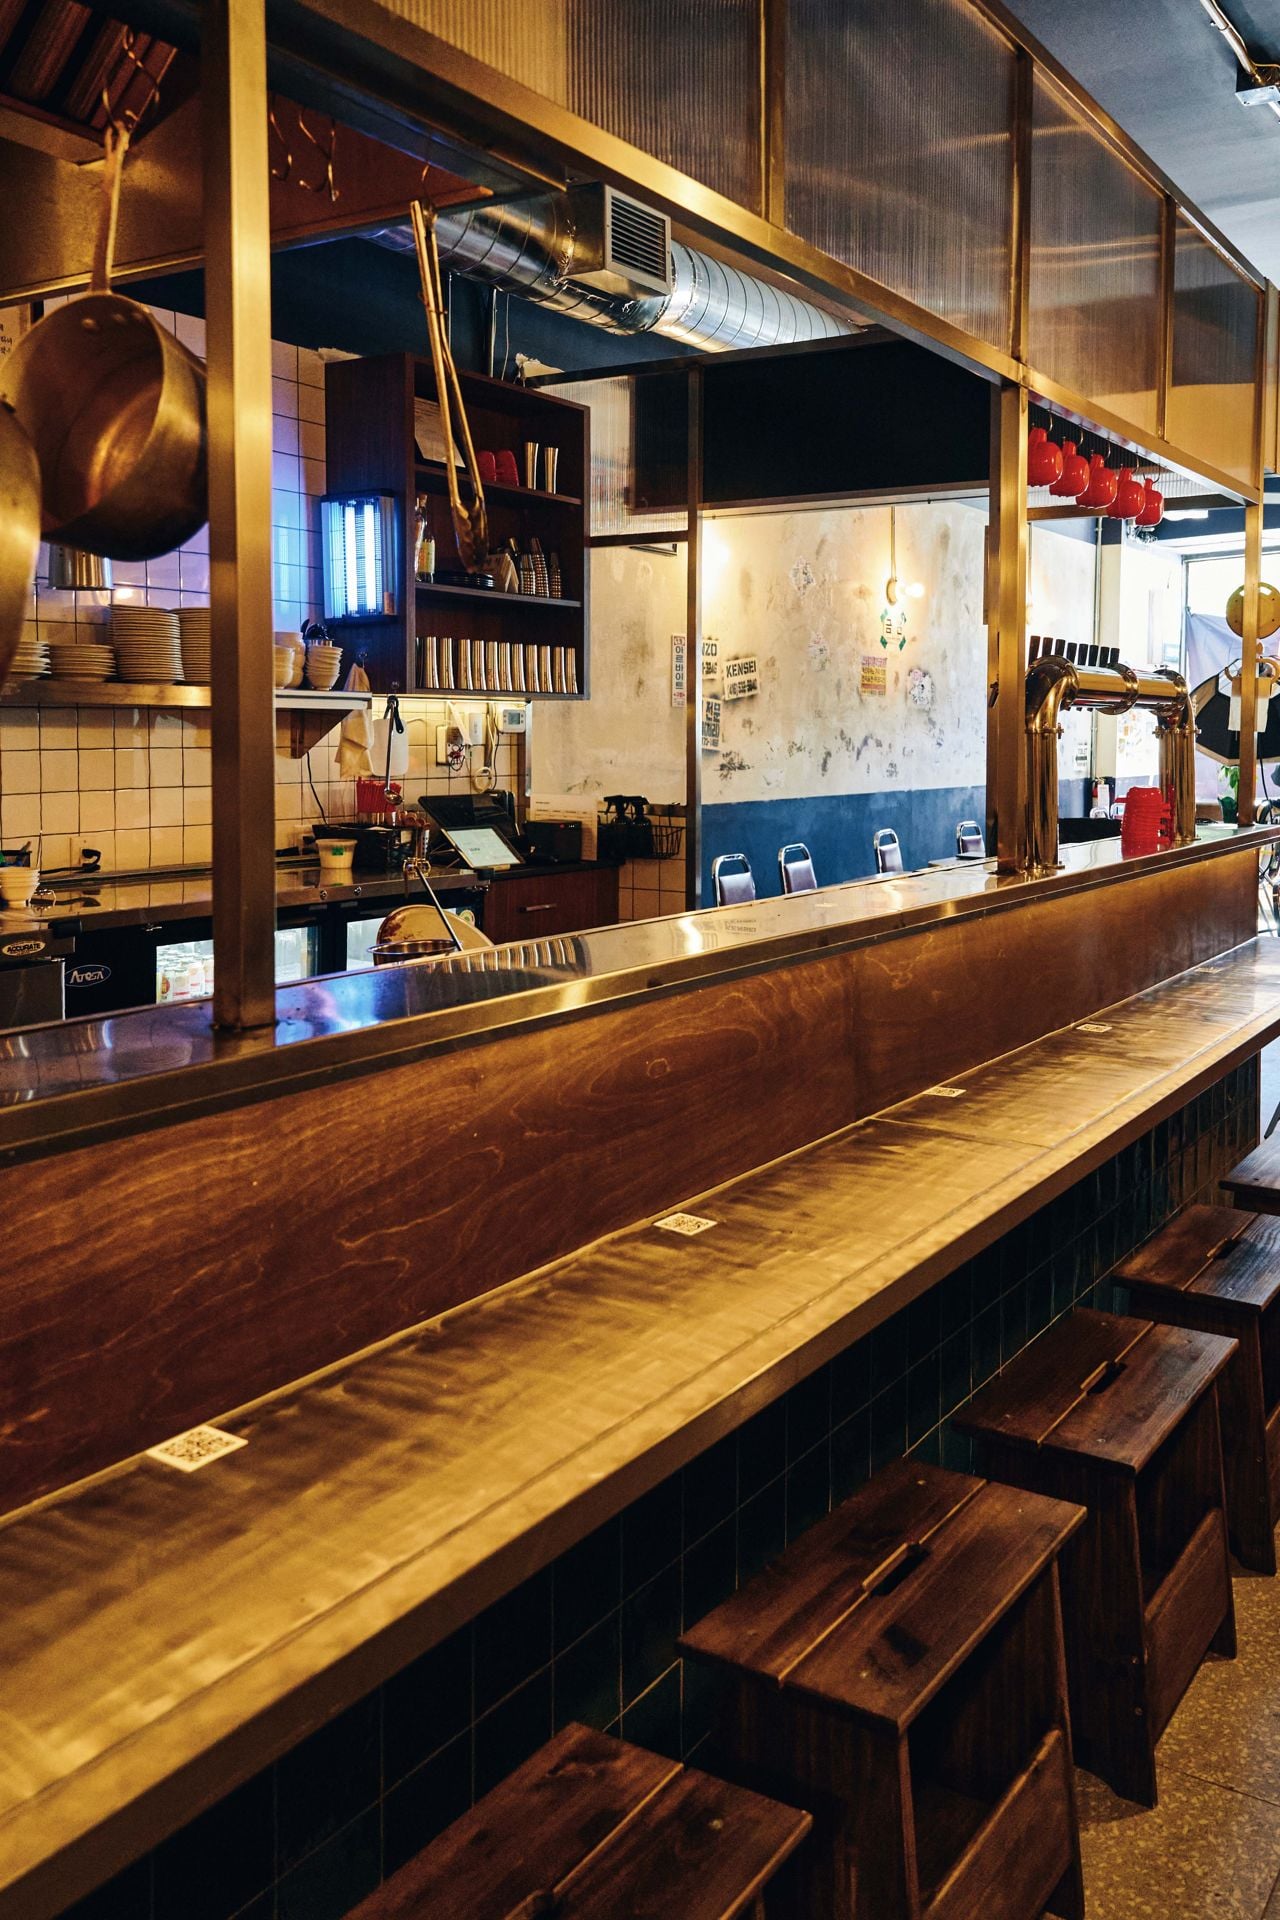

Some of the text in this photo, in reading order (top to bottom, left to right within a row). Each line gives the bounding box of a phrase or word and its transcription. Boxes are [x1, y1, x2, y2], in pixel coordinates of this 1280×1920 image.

[675, 645, 684, 690] 아르바이트
[726, 660, 757, 678] KENSEI
[7, 943, 41, 953] ACCURATE
